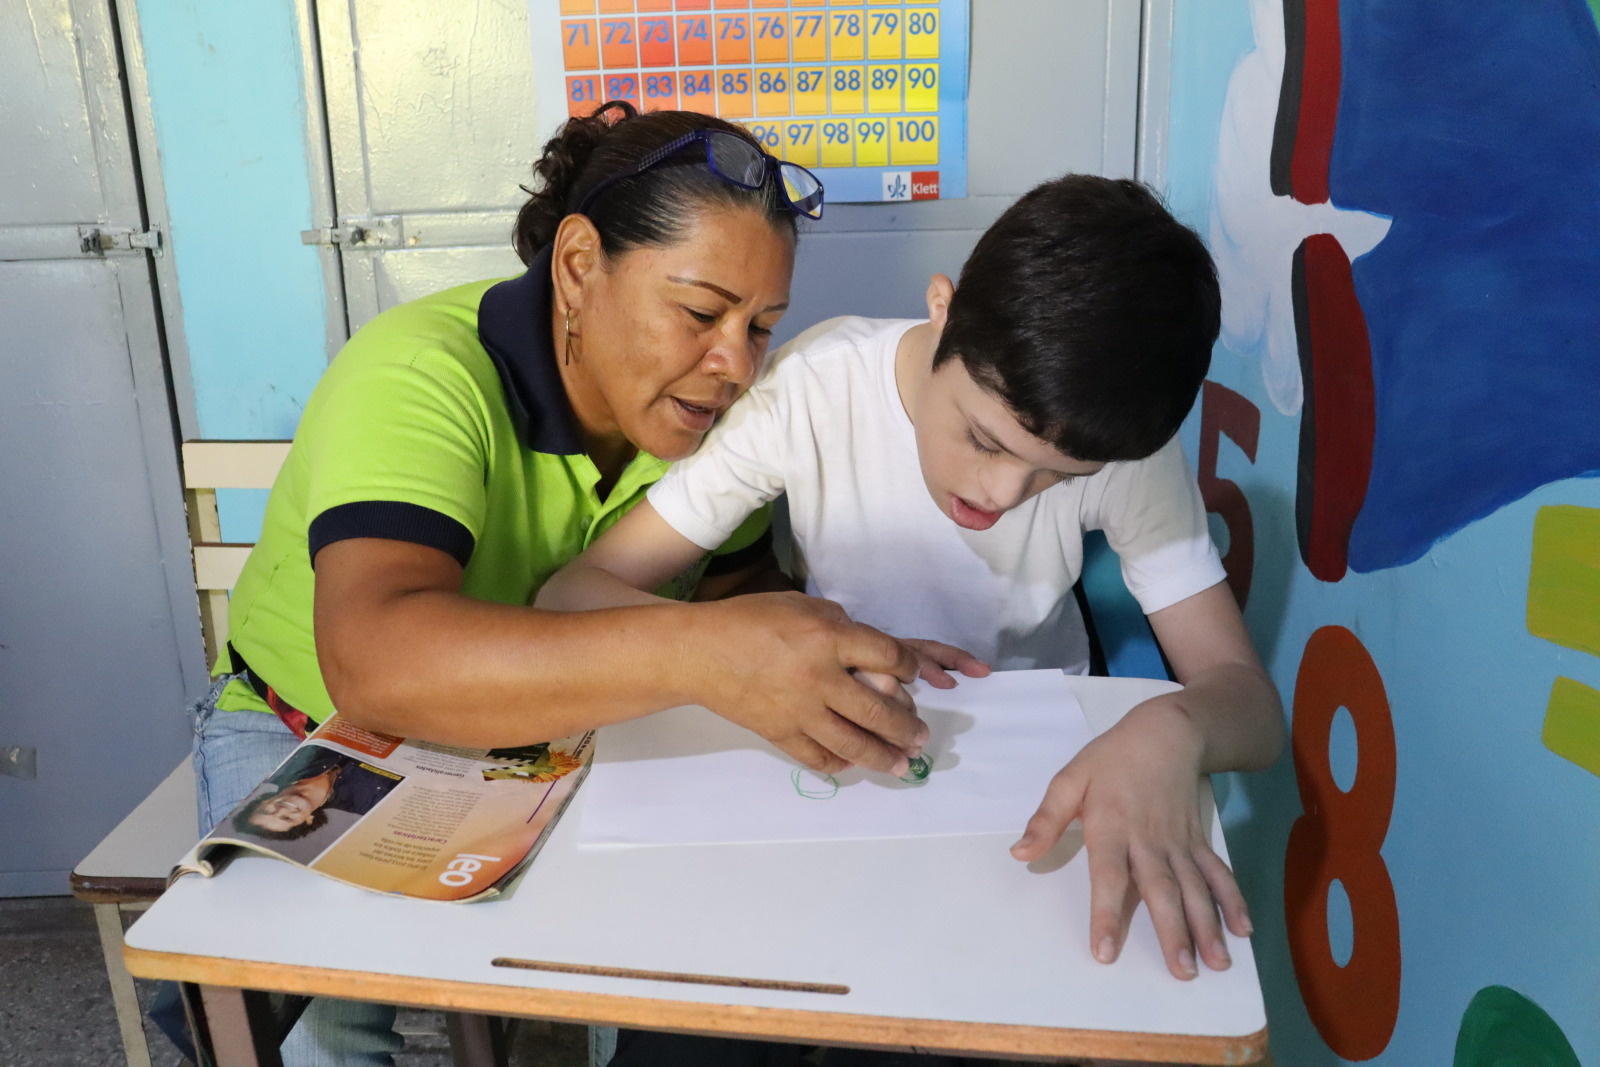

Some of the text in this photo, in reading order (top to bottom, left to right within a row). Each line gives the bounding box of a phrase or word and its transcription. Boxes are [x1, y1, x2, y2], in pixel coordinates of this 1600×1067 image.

[566, 13, 937, 47] 71 72 73 74 75 76 77 78 79 80
[571, 68, 937, 102] 81 82 83 84 85 86 87 88 89 90
[752, 120, 935, 148] 96 97 98 99 100
[912, 182, 938, 195] Klett
[416, 765, 465, 778] Generalidades
[1284, 625, 1401, 1062] 8
[439, 853, 501, 887] leo
